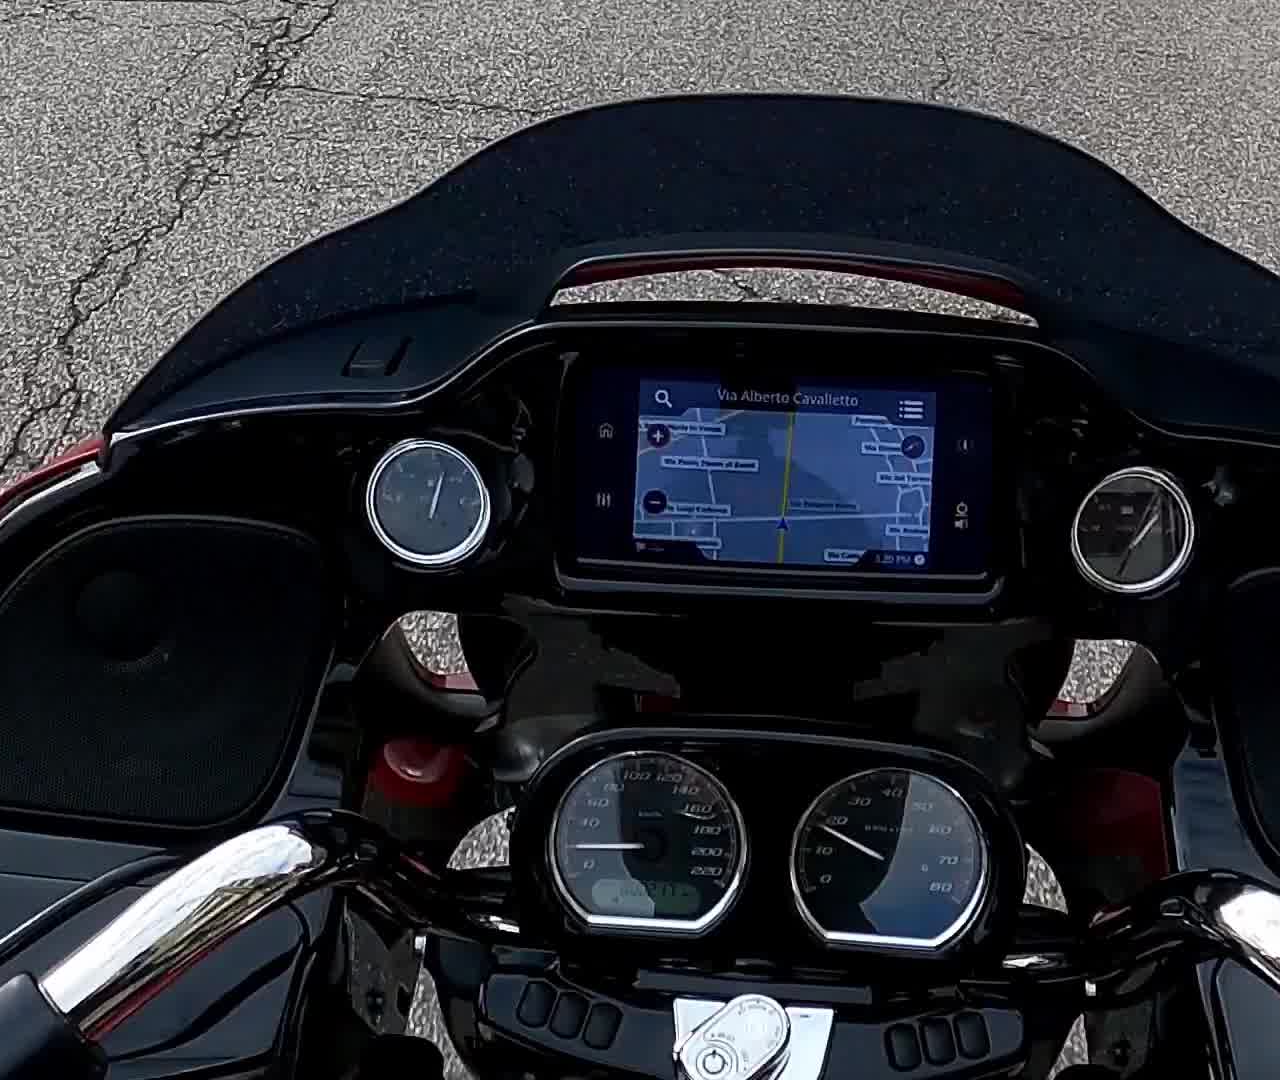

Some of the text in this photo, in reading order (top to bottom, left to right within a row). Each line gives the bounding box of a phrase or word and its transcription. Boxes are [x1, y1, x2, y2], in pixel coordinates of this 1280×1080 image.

[717, 388, 859, 406] Via Alberto Cavalletto
[684, 803, 713, 814] 160
